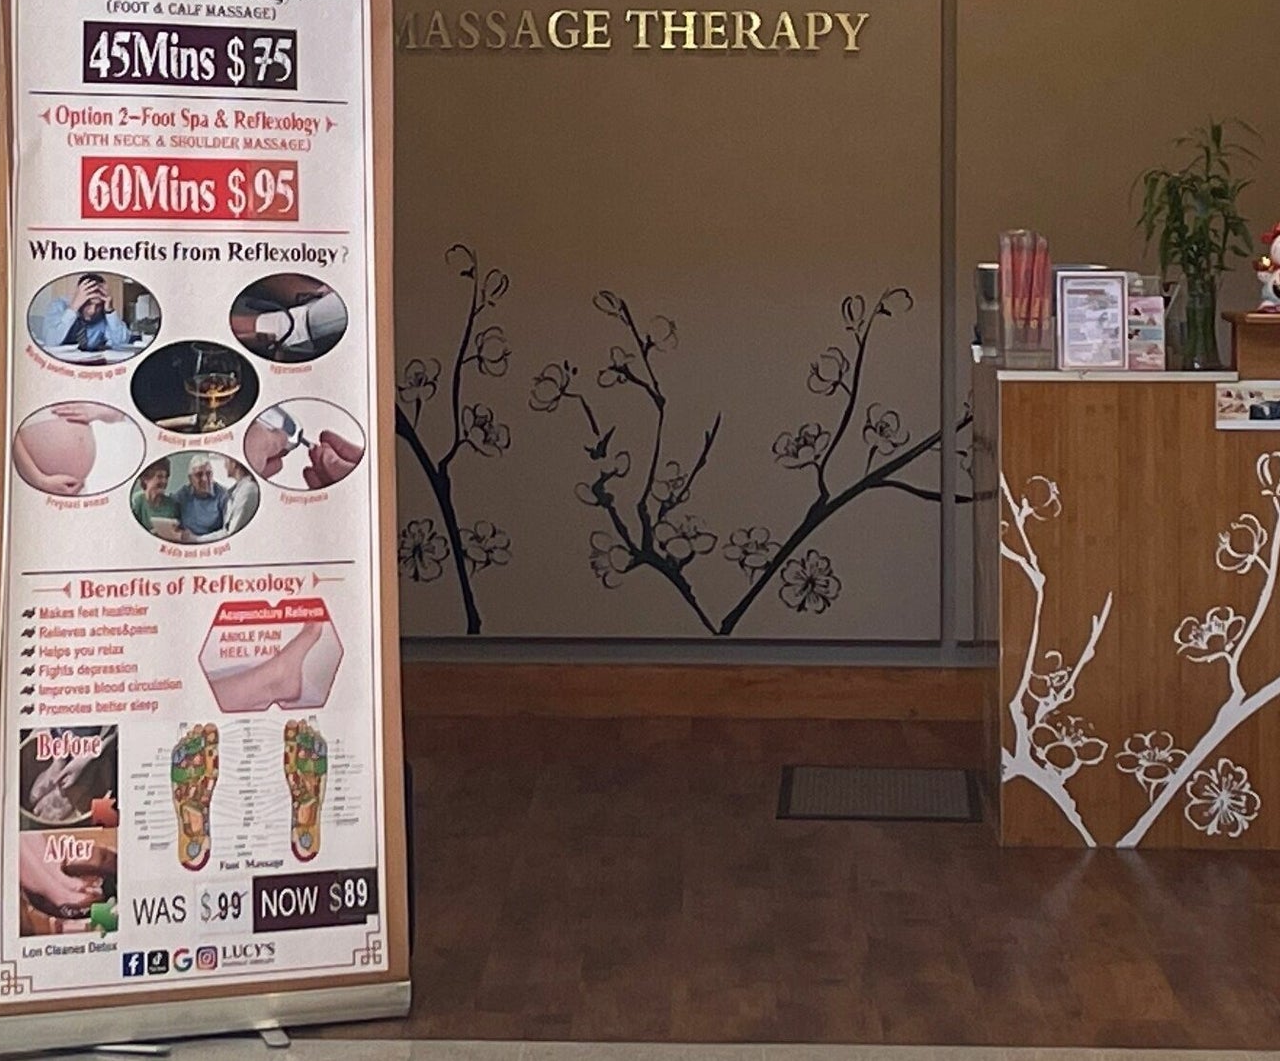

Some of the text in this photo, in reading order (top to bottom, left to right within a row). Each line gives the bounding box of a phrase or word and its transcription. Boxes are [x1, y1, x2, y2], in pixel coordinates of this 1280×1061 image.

[106, 0, 150, 15] (FOOT
[168, 2, 201, 17] CALF
[206, 3, 277, 21] MASSAGE)
[625, 11, 871, 52] THERAPY
[88, 30, 216, 82] 45Mins
[54, 104, 113, 126] Option
[181, 108, 210, 132] Spa
[213, 108, 229, 129] &
[234, 110, 321, 136] Reflexology
[87, 164, 217, 214] 60Mins
[253, 167, 294, 214] 95
[29, 240, 77, 261] Who
[83, 240, 167, 262] benefits
[172, 241, 221, 262] from
[80, 573, 306, 599] Benefits of Reflexology
[258, 629, 282, 641] PAIN
[39, 643, 124, 660] Helps you relax
[220, 644, 282, 659] HEEL PAIN
[39, 664, 74, 680] Fights
[94, 681, 125, 694] blood
[35, 732, 103, 762] Before
[43, 835, 97, 865] After
[133, 894, 187, 927] WAS
[260, 885, 320, 919] NOW
[221, 941, 276, 960] LUCY'S
